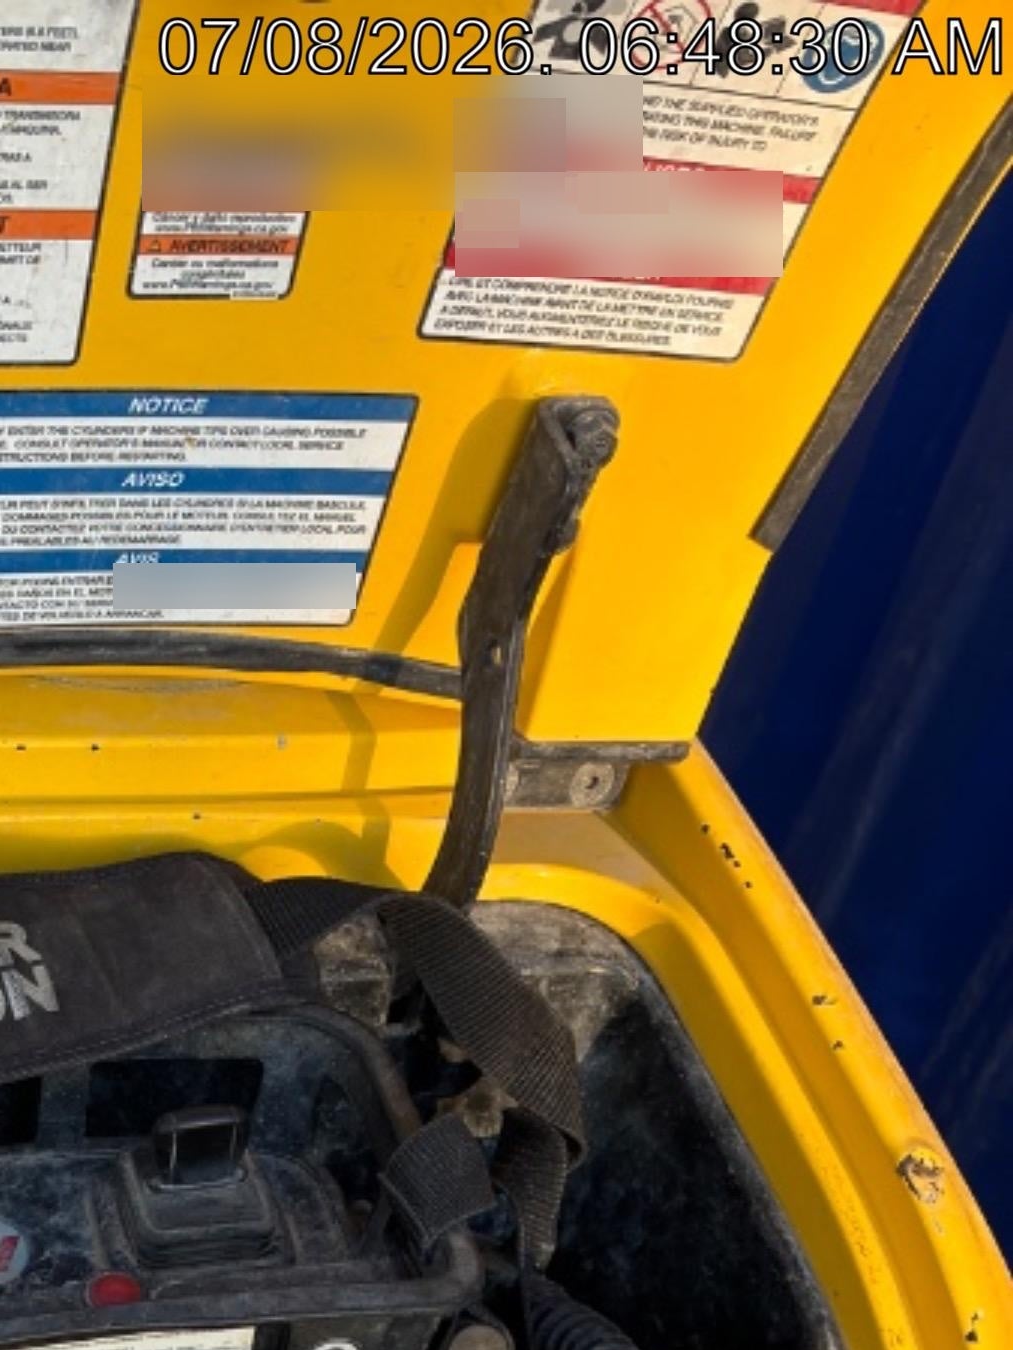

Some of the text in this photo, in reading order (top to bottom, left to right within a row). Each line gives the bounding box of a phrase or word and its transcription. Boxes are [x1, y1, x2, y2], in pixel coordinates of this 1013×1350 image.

[170, 239, 291, 254] AVERTISSEMENT
[128, 397, 208, 415] NOTICE
[122, 471, 185, 488] AVISO
